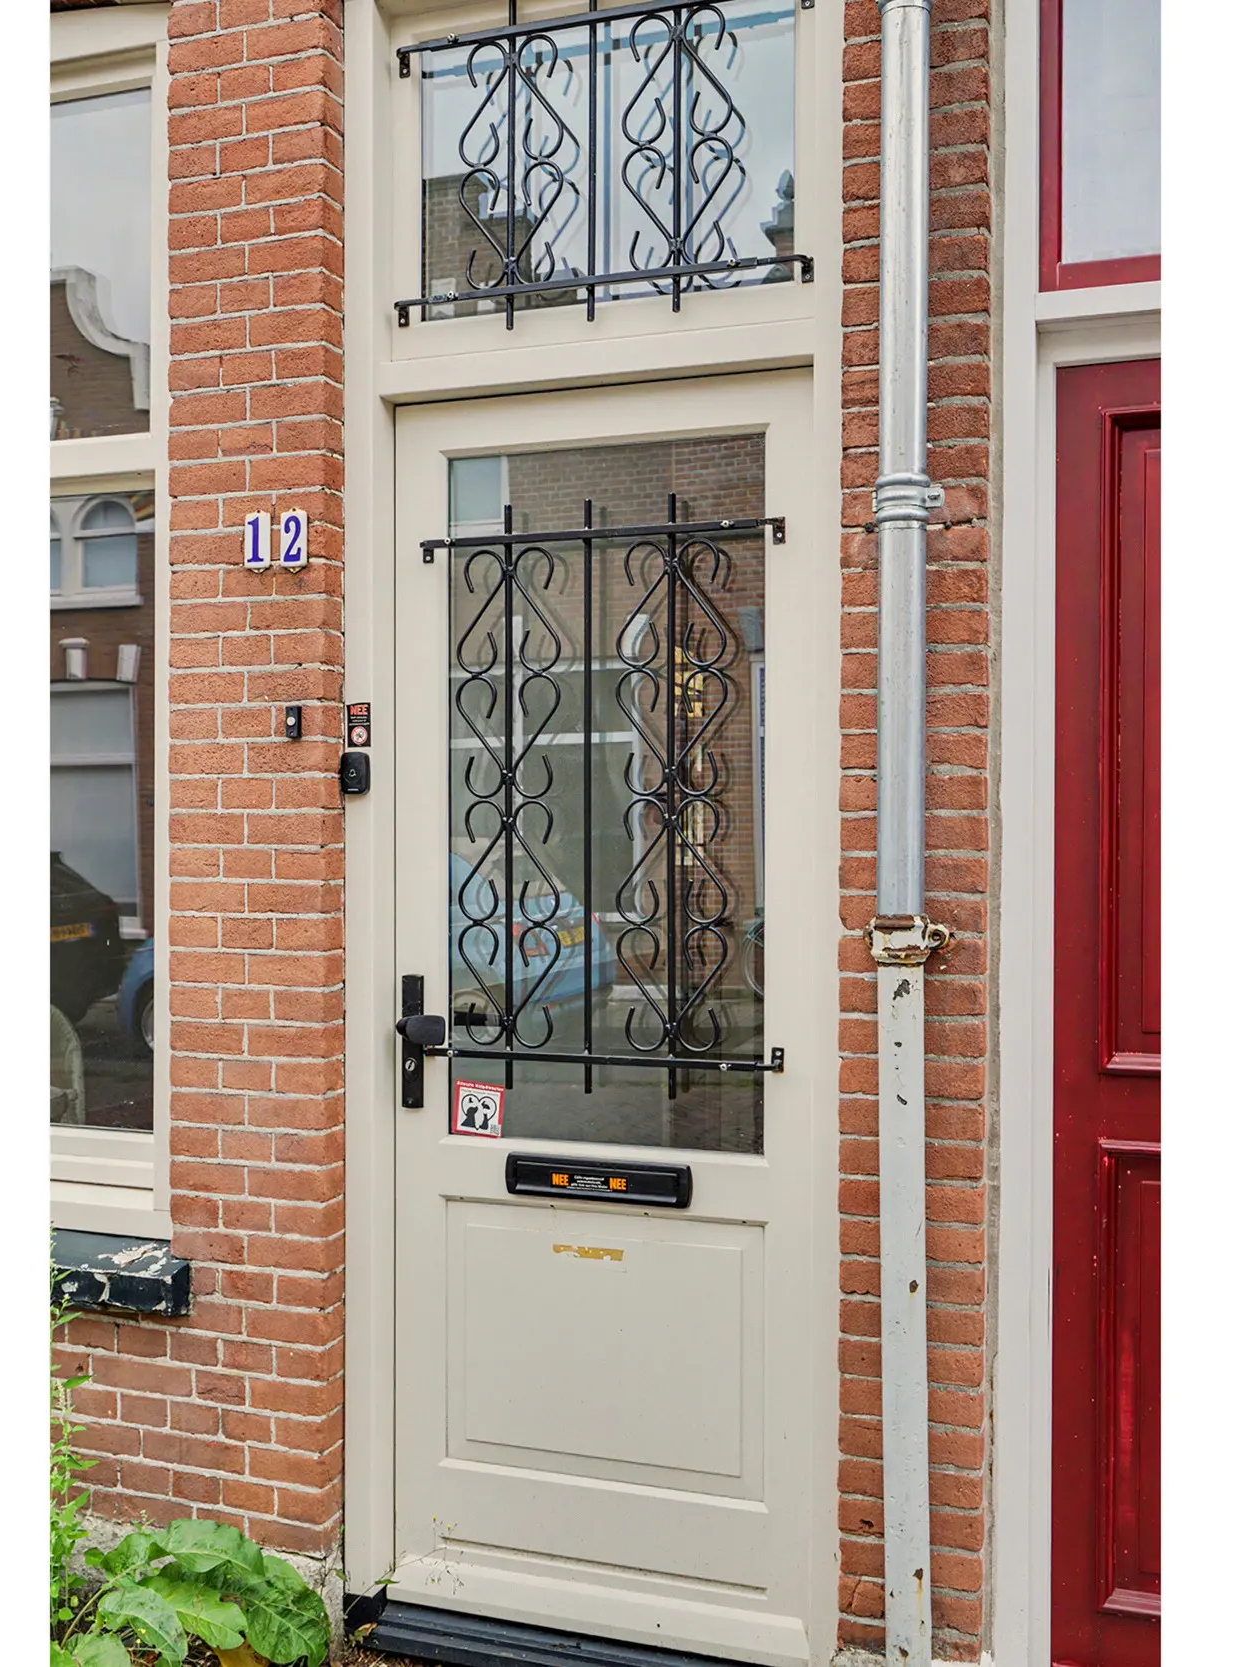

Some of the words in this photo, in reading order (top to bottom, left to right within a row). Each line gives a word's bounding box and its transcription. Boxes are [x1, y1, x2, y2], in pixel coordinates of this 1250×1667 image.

[247, 515, 301, 563] 12
[350, 704, 368, 715] NEE
[552, 1173, 569, 1186] NEE
[609, 1177, 627, 1190] NEE
